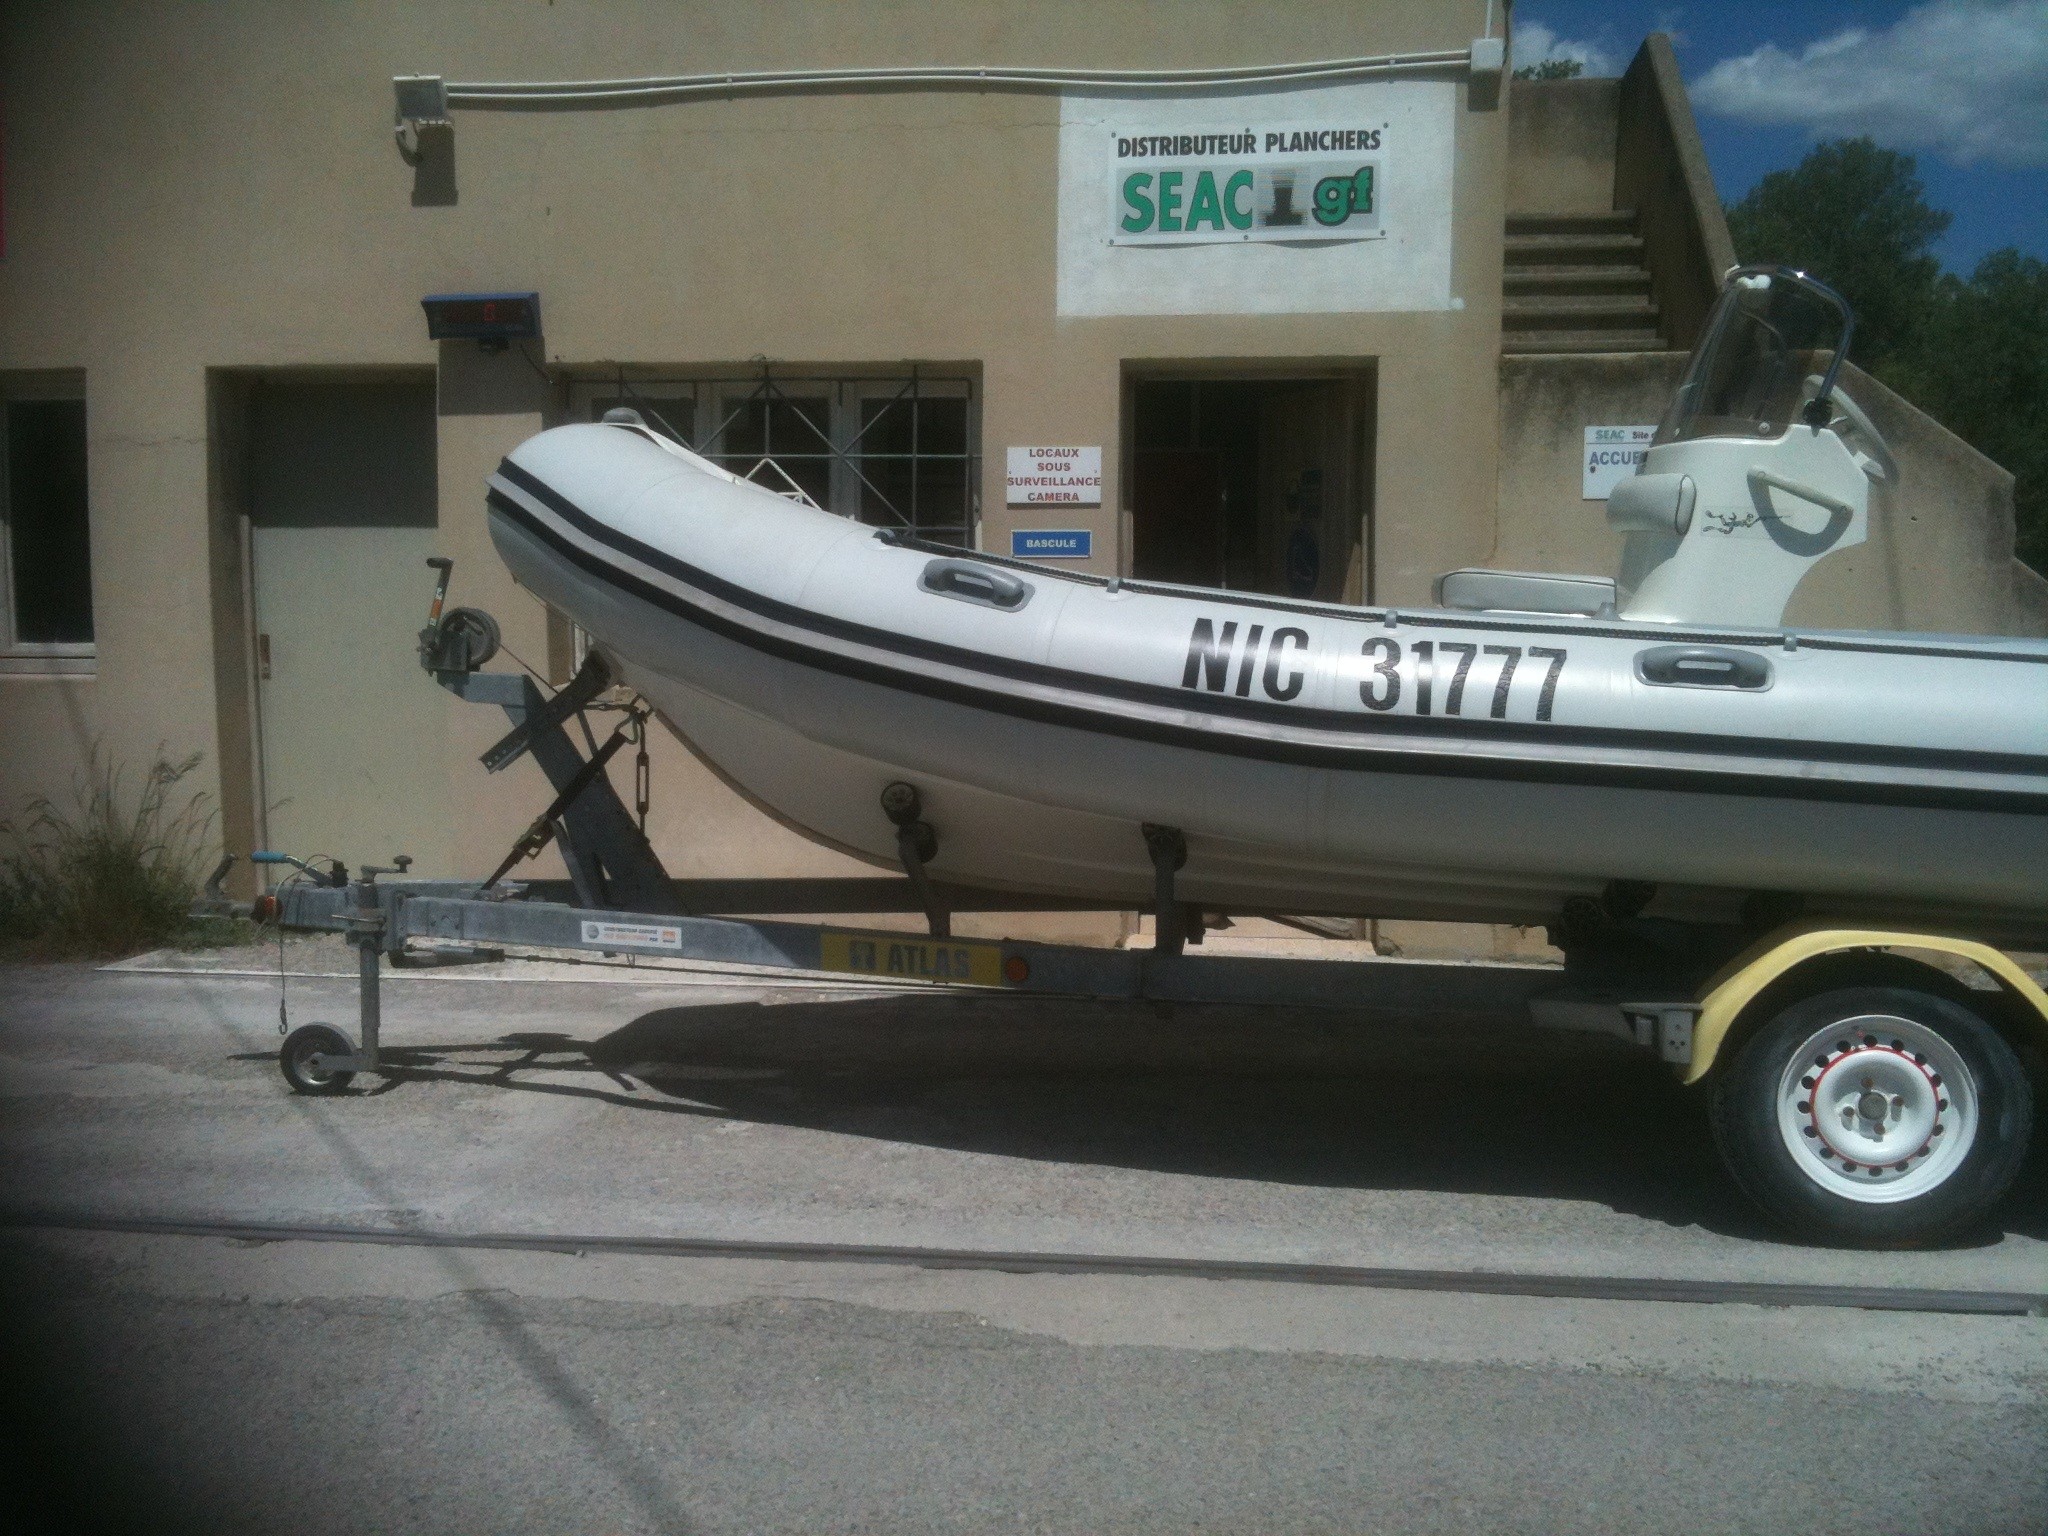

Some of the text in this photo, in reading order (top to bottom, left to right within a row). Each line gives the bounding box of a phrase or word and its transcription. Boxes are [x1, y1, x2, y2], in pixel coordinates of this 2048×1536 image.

[1118, 130, 1381, 158] DISTRIBUTEUR PLANCHERS
[1121, 170, 1254, 232] SEAC
[1595, 430, 1625, 440] SEAC
[1029, 448, 1080, 458] LOCAUX
[1037, 462, 1071, 472] SOUS
[1007, 477, 1101, 486] SURVEILLANCE
[1027, 492, 1080, 502] CAMERA
[1026, 539, 1077, 548] BASCULE
[1181, 617, 1568, 721] NIC 31777
[889, 944, 970, 978] ATLAS
